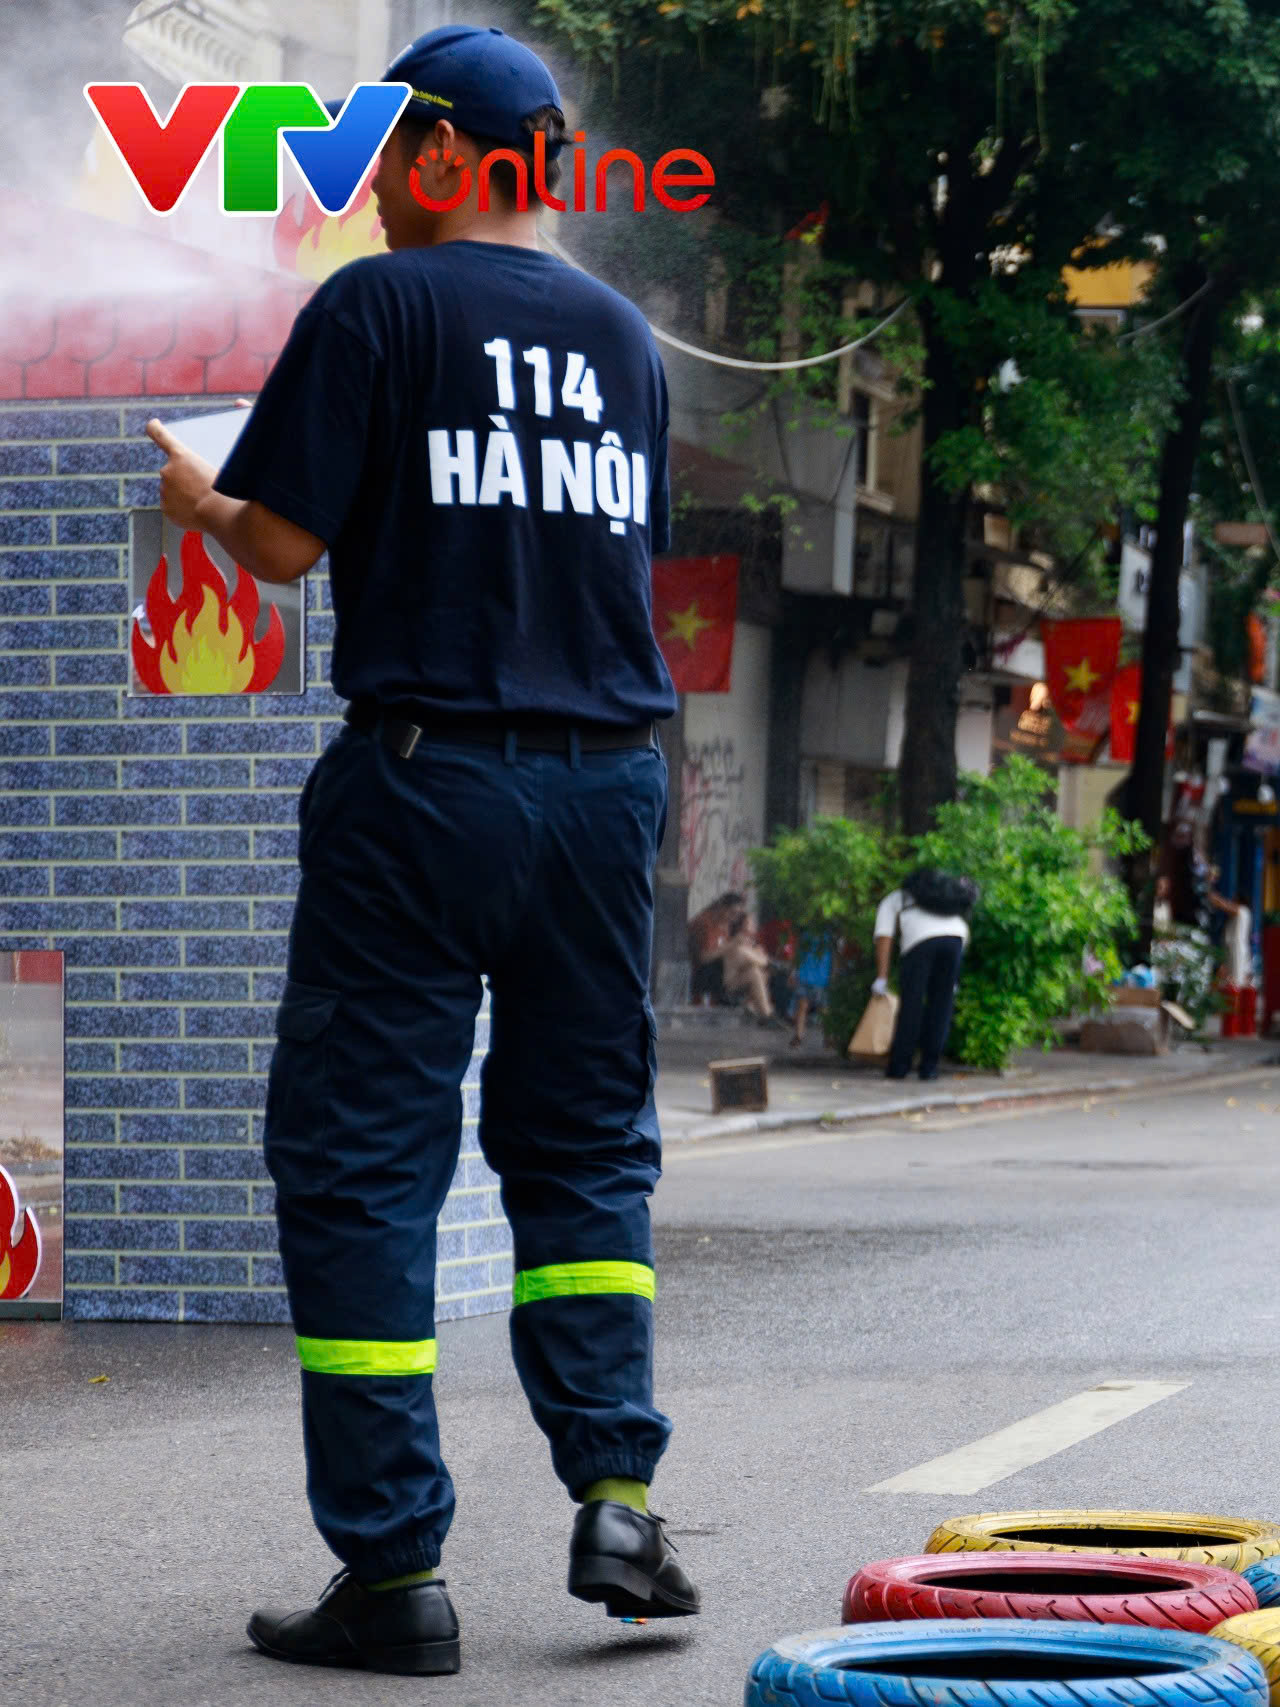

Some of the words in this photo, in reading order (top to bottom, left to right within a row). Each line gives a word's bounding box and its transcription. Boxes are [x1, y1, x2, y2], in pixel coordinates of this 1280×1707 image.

[484, 338, 603, 423] 114
[428, 414, 527, 508] HÀ
[540, 430, 647, 535] NỘI
